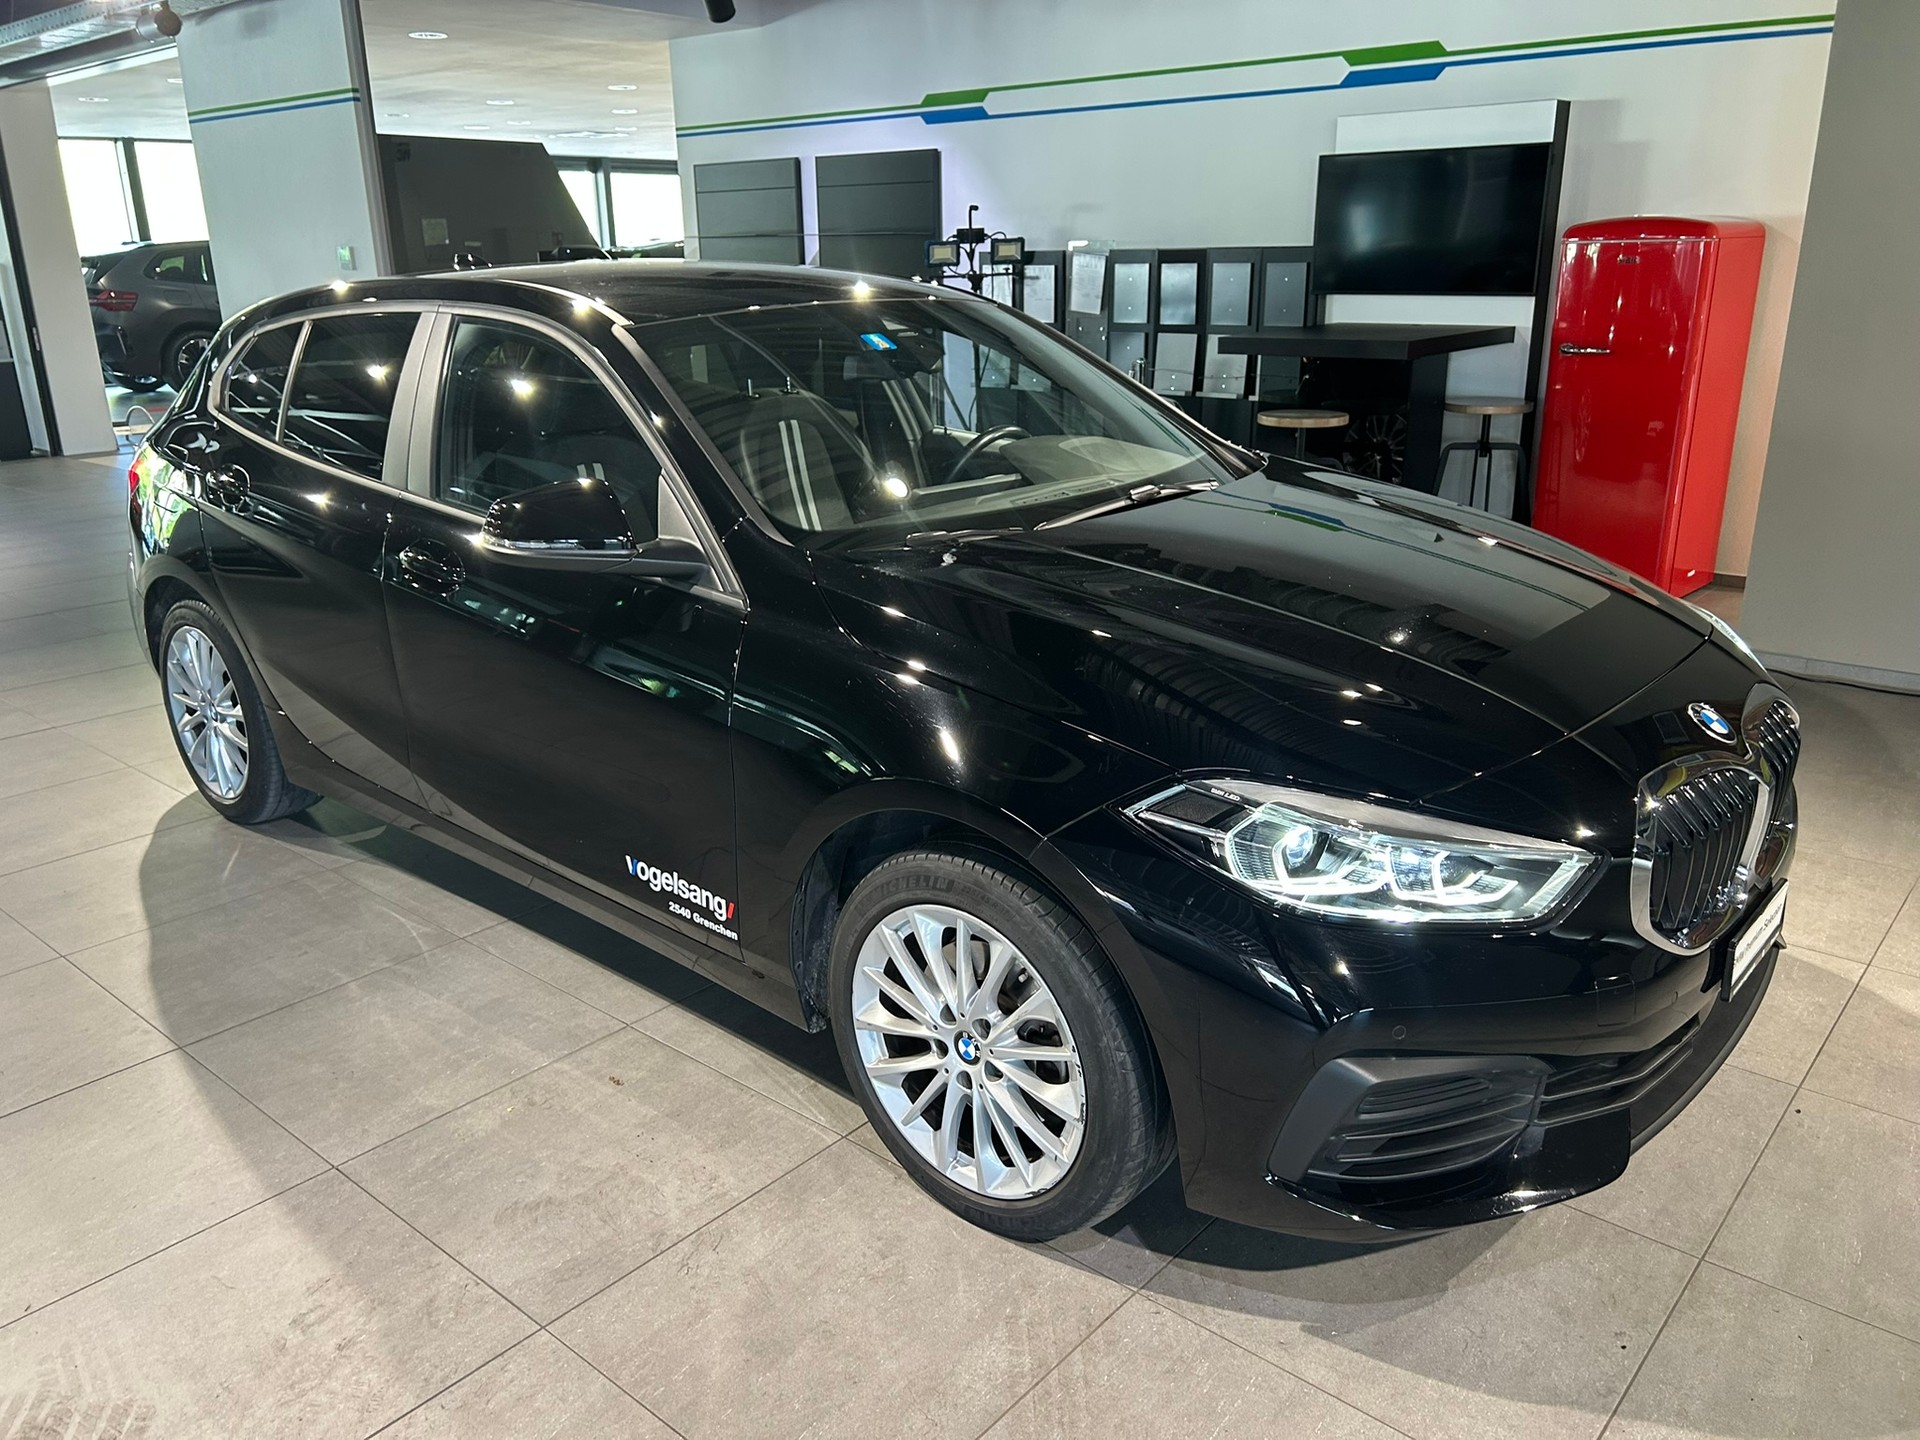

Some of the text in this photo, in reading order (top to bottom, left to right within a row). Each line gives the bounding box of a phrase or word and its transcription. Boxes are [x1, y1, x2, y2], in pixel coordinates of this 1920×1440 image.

[1224, 792, 1240, 801] LED
[875, 875, 949, 897] MICHELIN
[668, 901, 739, 941] 2540 Grenchen
